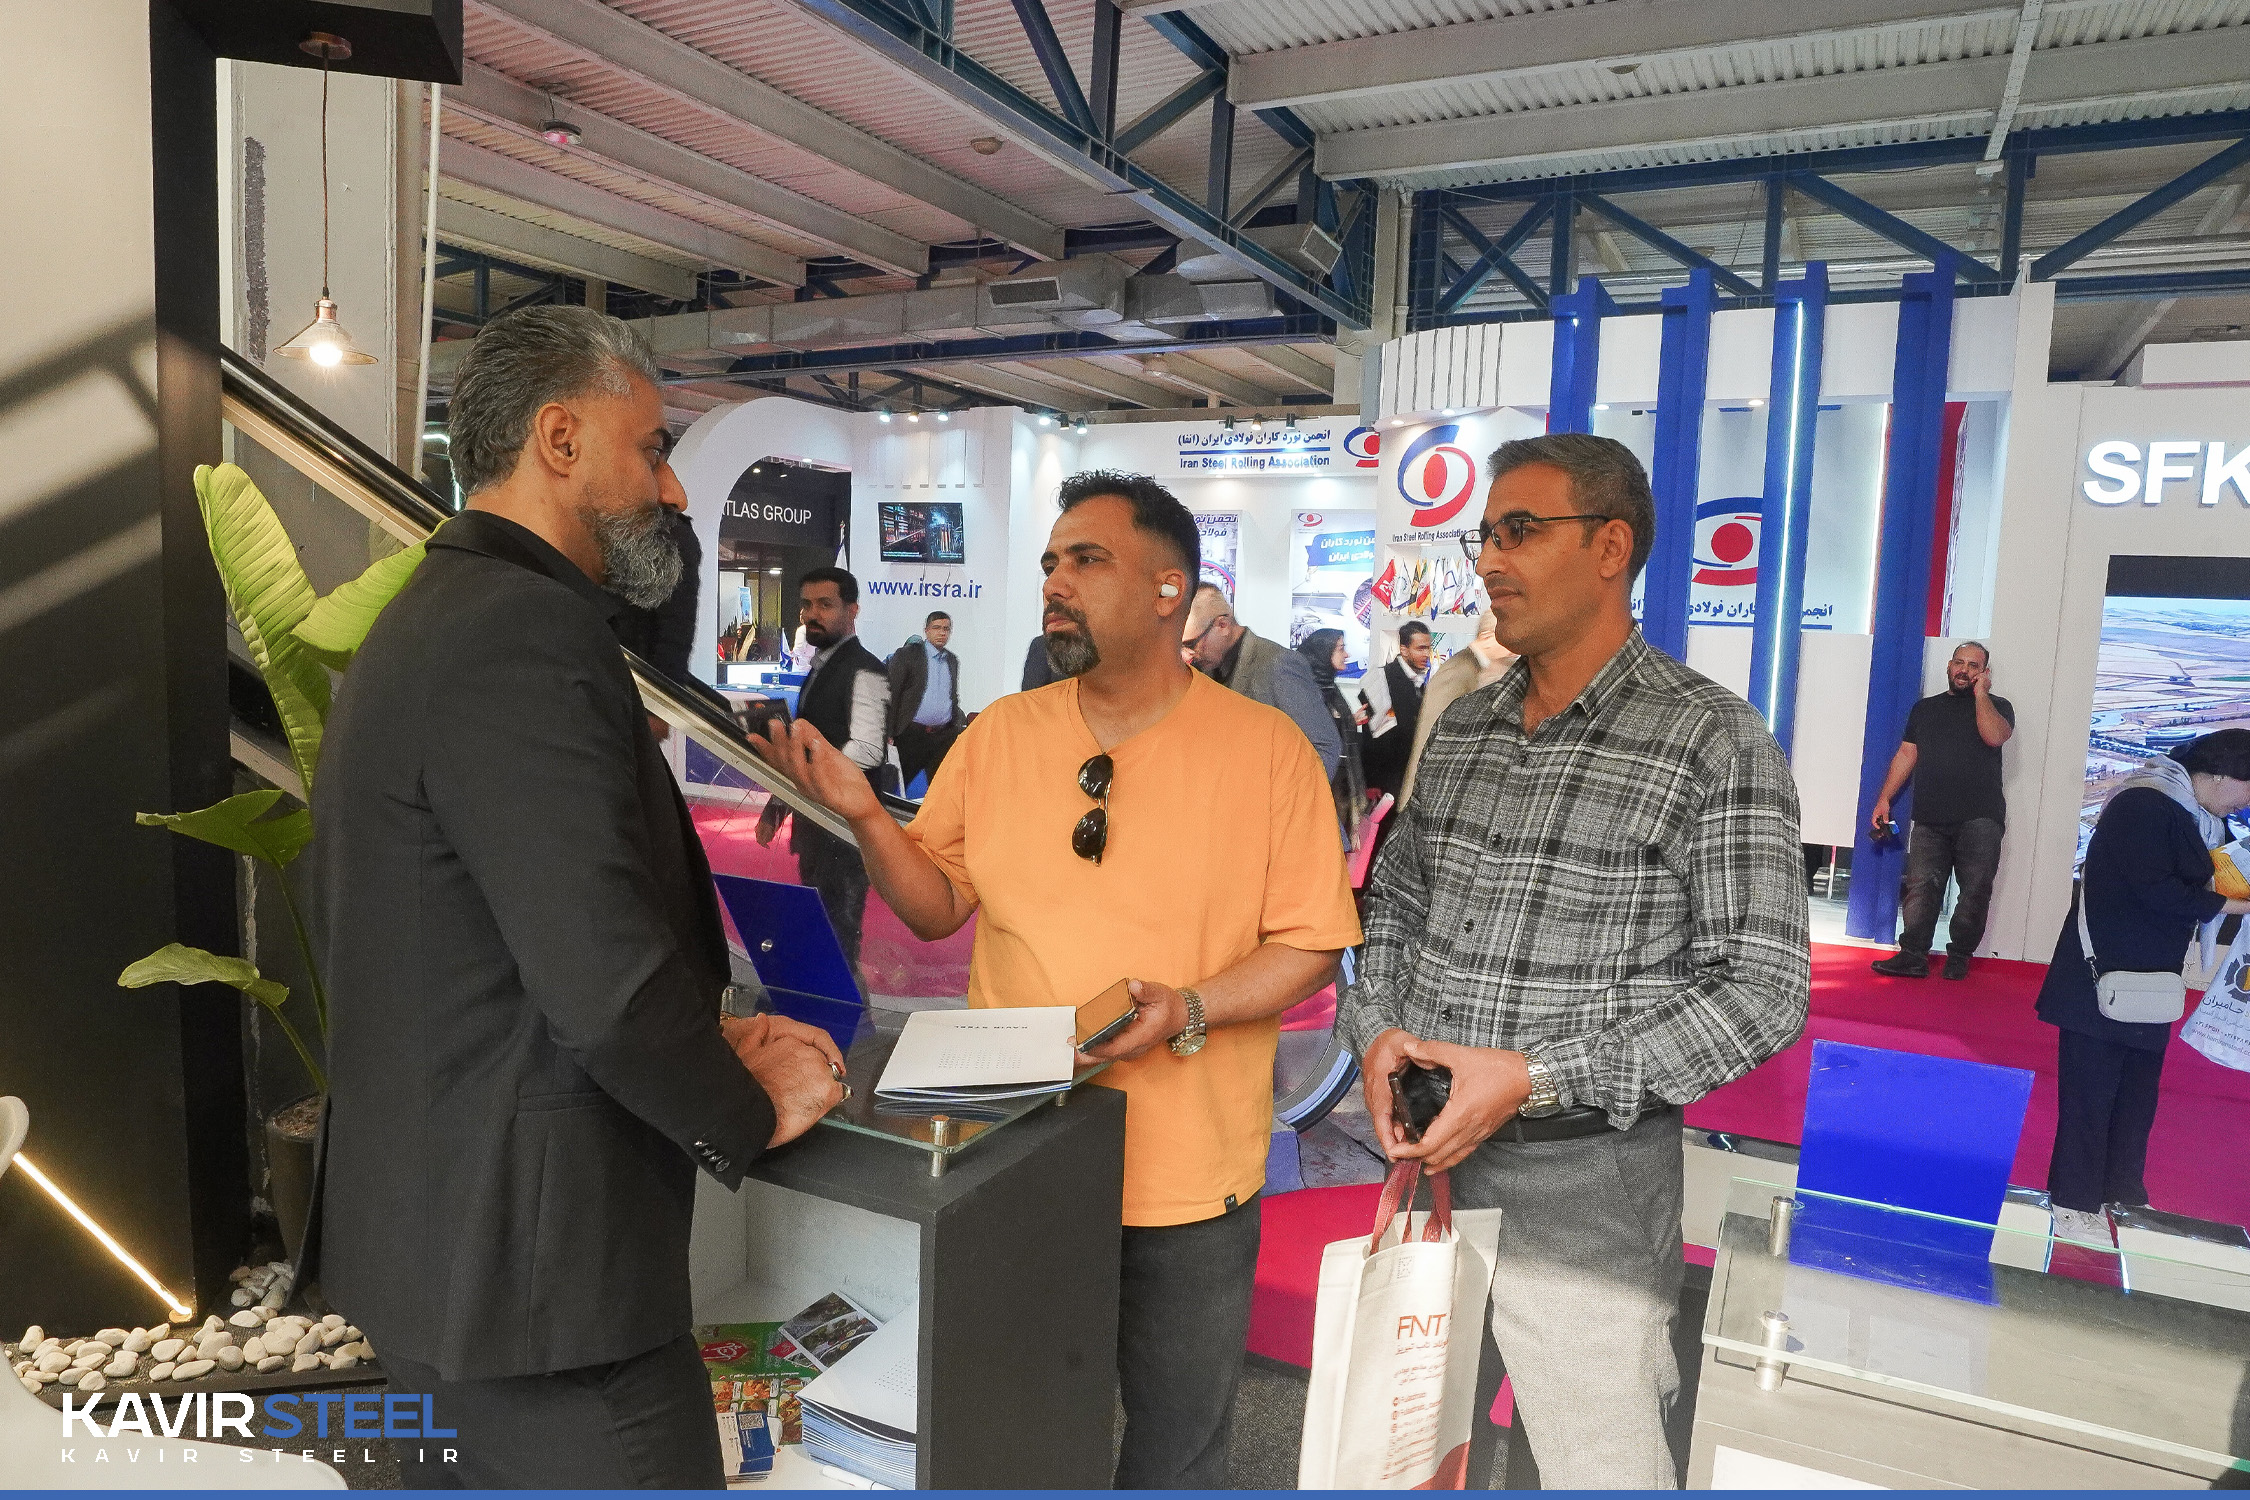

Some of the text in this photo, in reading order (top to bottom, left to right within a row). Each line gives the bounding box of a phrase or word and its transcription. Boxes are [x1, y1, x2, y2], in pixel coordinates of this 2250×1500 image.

[1201, 433, 1224, 446] ایران
[1224, 431, 1254, 446] فولادی
[1255, 431, 1281, 445] کاران
[1283, 430, 1302, 445] نورد
[1303, 429, 1331, 443] انجمن
[1180, 454, 1330, 469] Iran Steel Rolling Association
[2083, 441, 2250, 504] SFK
[723, 500, 812, 524] TLAS GROUP
[1392, 535, 1403, 543] Iran
[1403, 532, 1417, 542] Steel
[1417, 531, 1435, 542] Rolling
[868, 577, 983, 598] www.irsra.ir
[1802, 603, 1833, 619] انجم
[1397, 1313, 1447, 1340] FNT
